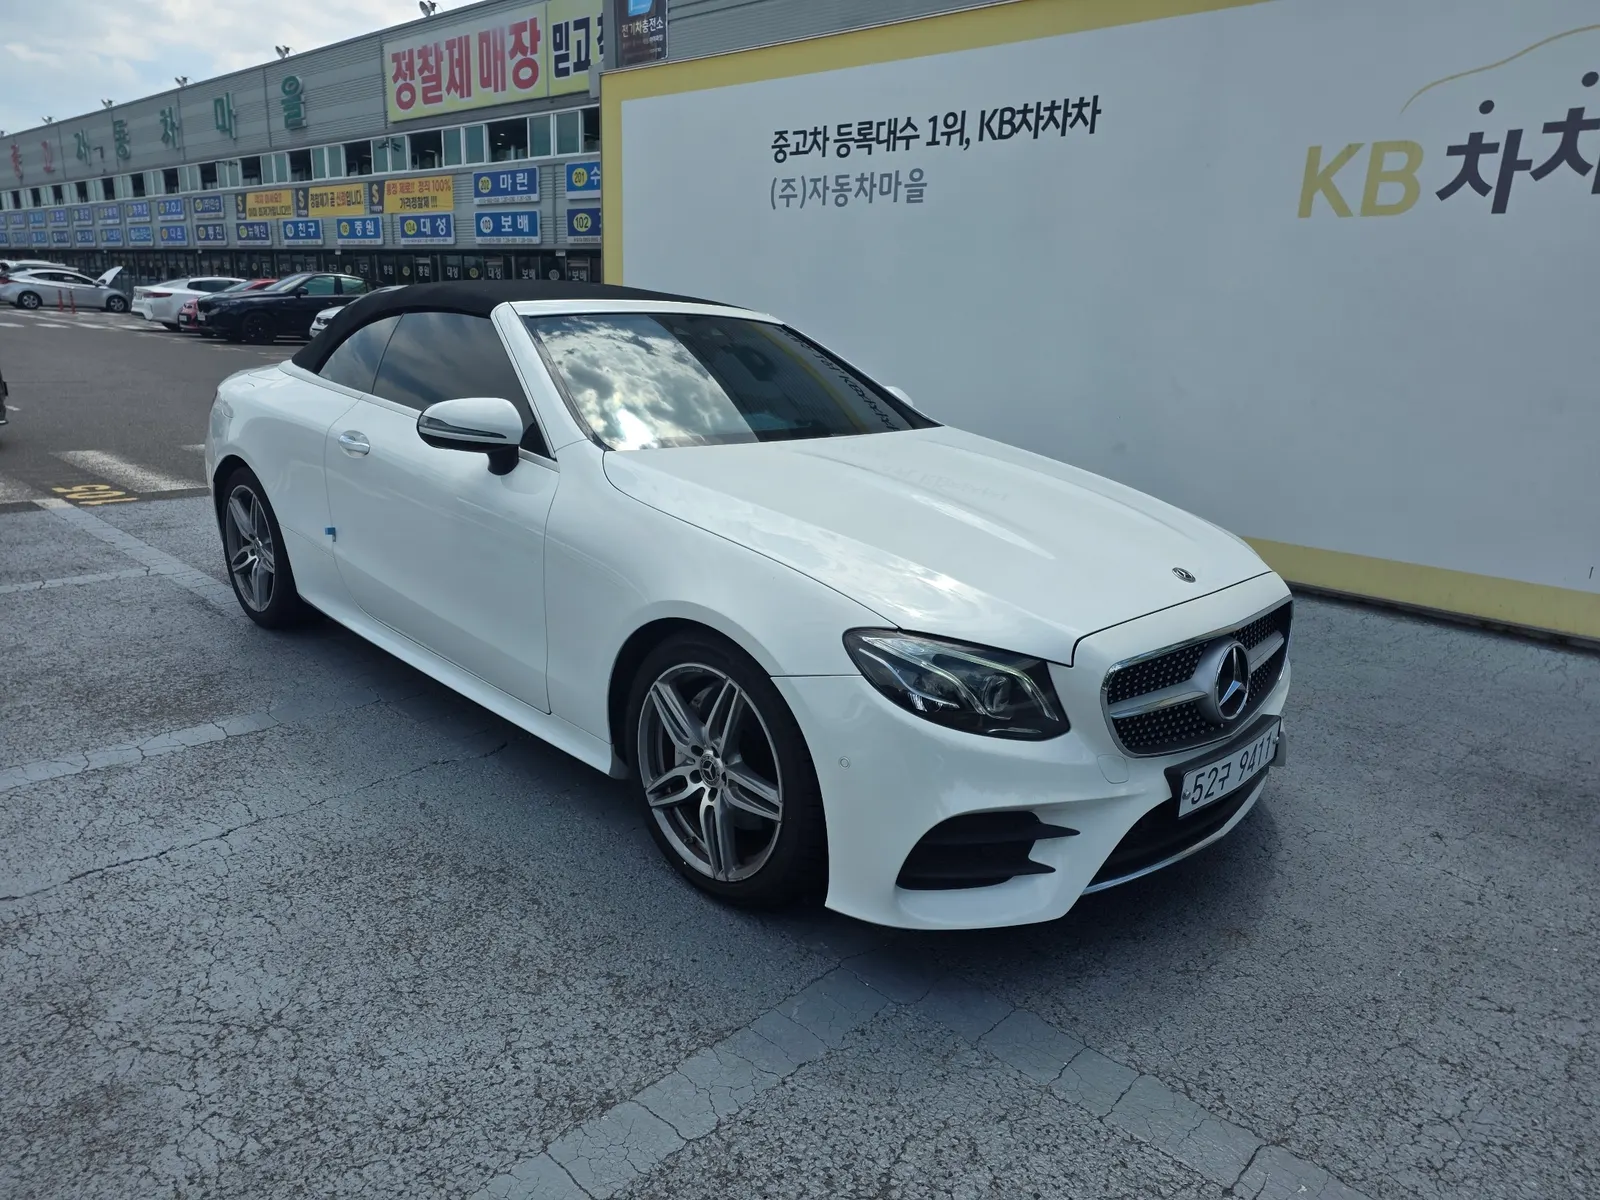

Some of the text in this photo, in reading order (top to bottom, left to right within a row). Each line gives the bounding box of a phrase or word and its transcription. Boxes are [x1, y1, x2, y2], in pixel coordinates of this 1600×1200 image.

[621, 16, 664, 38] 전기차충전소
[552, 16, 590, 78] 믿고
[390, 34, 472, 110] 정찰제
[478, 17, 541, 93] 매장
[73, 75, 306, 165] 자동차마을
[771, 95, 1102, 163] 중고차 등록대수 1위, KB차차차
[432, 179, 452, 192] 100%
[500, 172, 528, 191] 마린
[770, 167, 928, 210] (주)자동차마을
[298, 222, 315, 237] 친구
[354, 220, 374, 236] 중원
[420, 218, 446, 235] 대성
[482, 214, 529, 232] 103 보배
[575, 216, 589, 229] 102
[446, 266, 459, 279] 대성
[521, 268, 536, 280] 보배
[571, 270, 587, 281] 보배
[1190, 731, 1273, 805] 52구 9411
